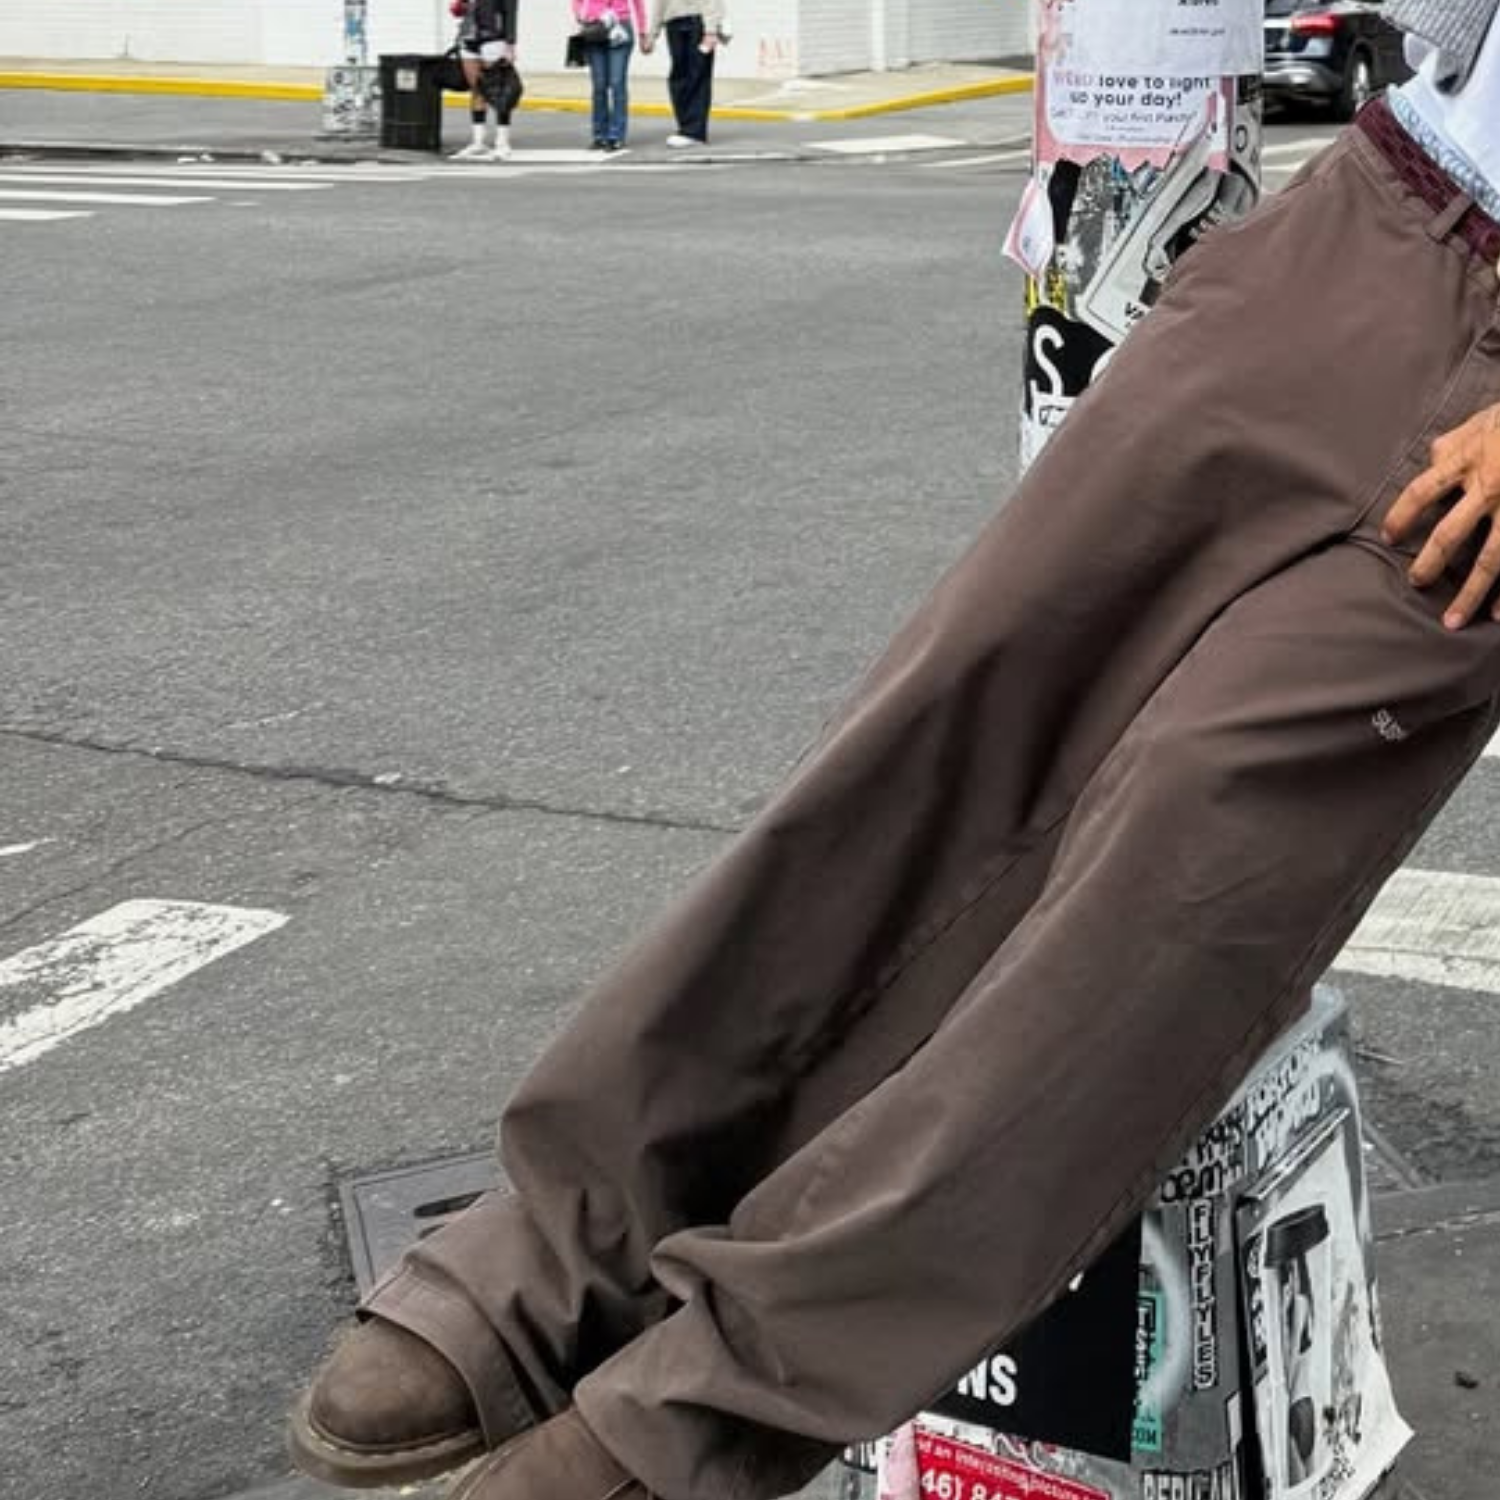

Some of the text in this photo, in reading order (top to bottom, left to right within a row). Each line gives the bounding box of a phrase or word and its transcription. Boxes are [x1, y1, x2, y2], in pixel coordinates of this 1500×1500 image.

[1098, 74, 1139, 89] love
[1144, 76, 1164, 90] to
[1093, 93, 1135, 109] your
[1140, 91, 1182, 109] day!
